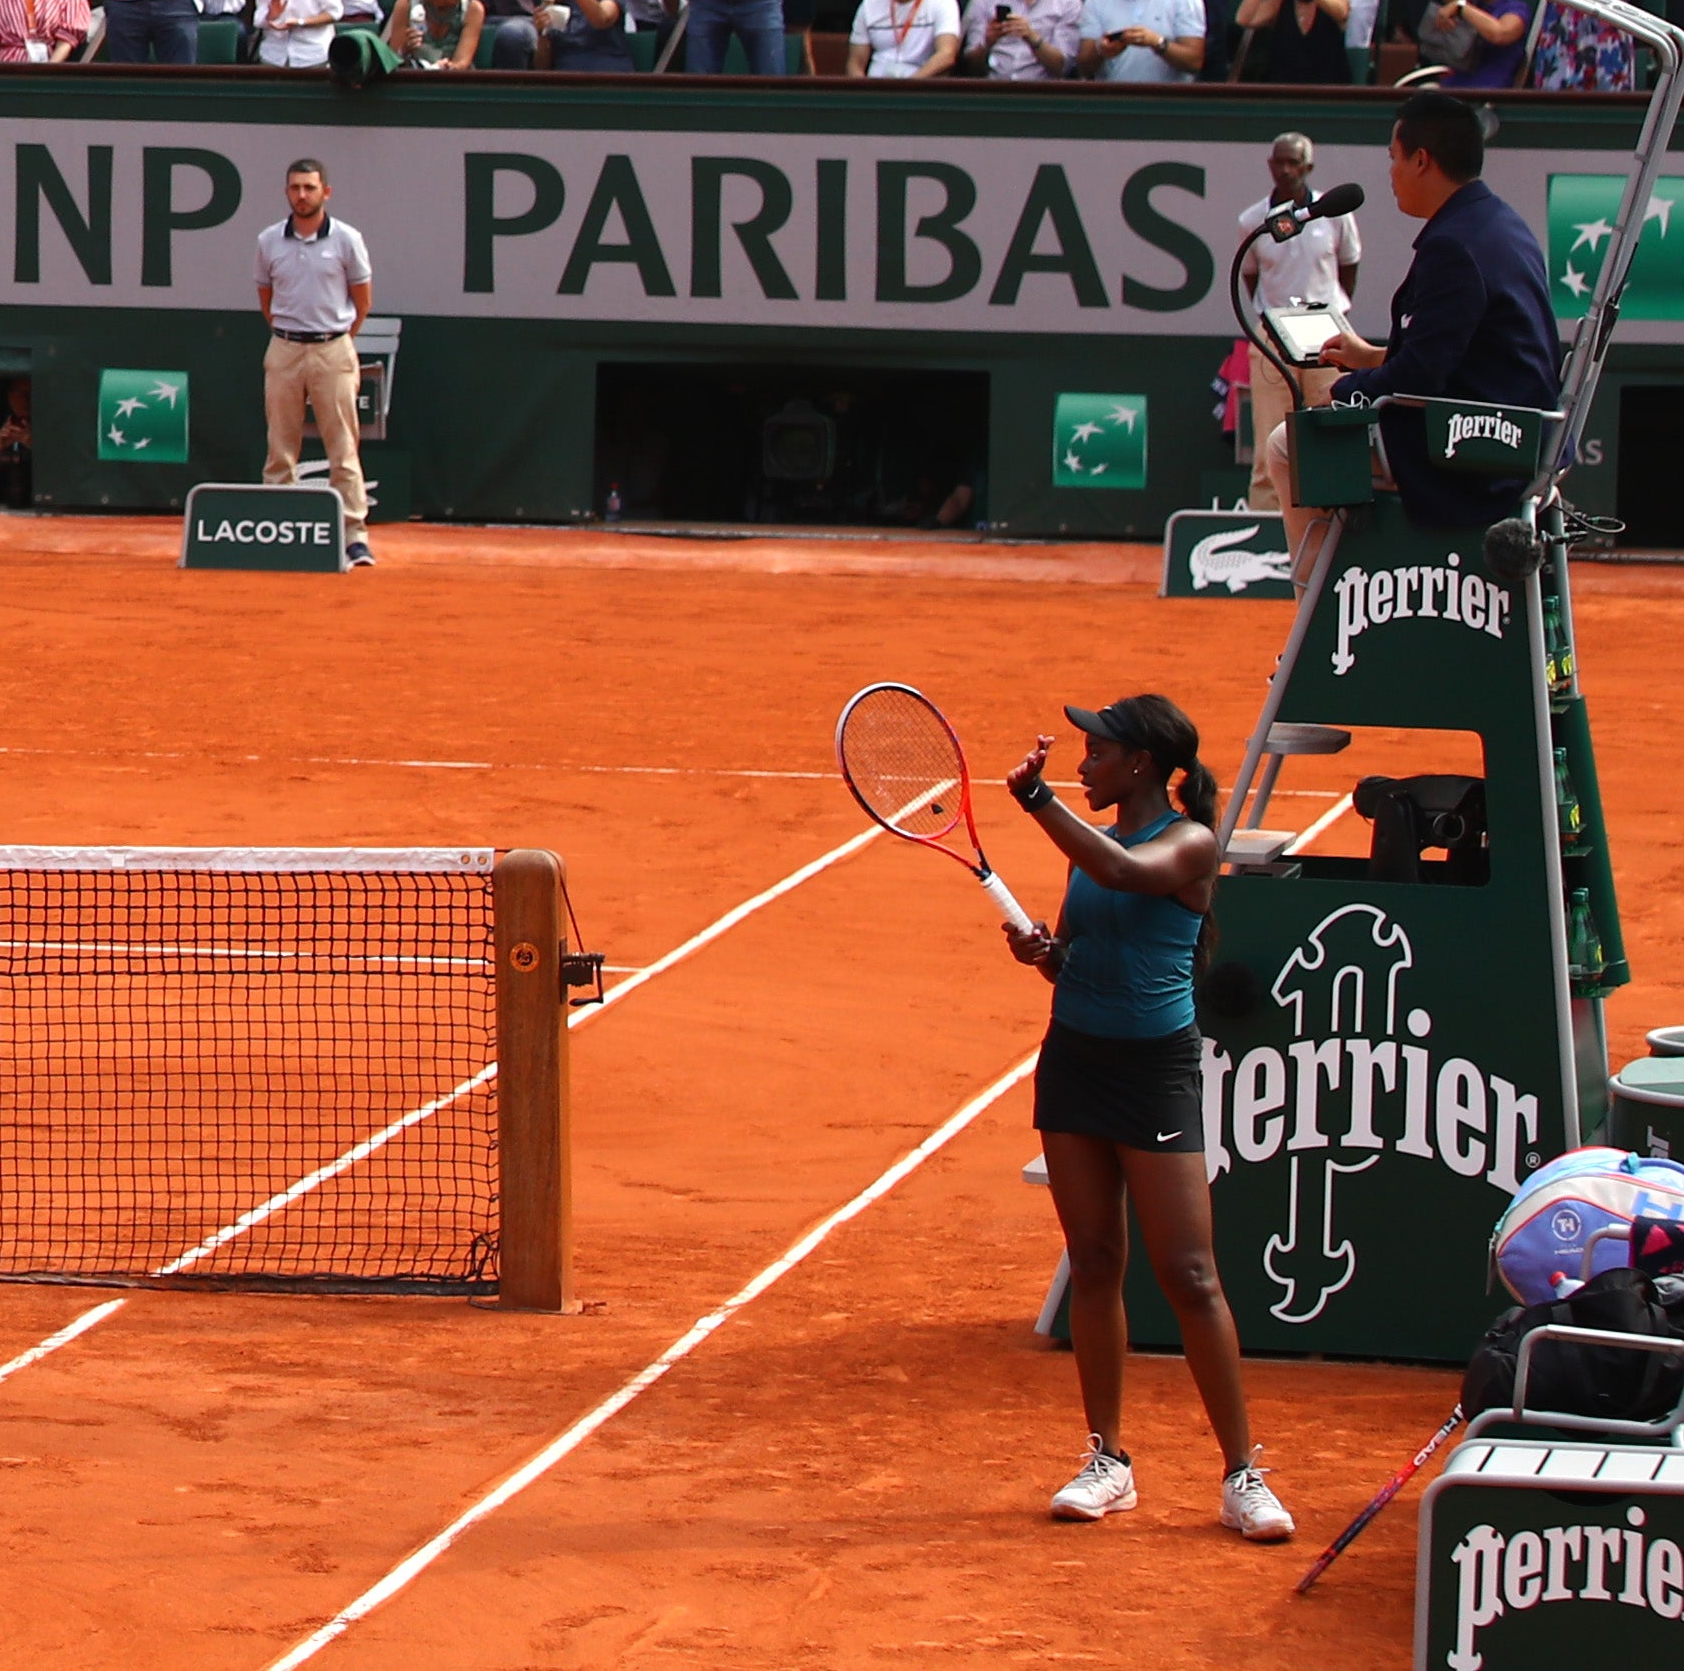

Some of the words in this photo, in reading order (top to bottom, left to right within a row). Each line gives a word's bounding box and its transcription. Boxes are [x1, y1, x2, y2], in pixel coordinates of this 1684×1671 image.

[462, 151, 1215, 314] PARIBAS
[1445, 410, 1522, 460] perrier
[197, 519, 331, 545] LACOSTE
[1331, 552, 1510, 676] perrier
[1413, 1416, 1459, 1466] HEAD
[1446, 1505, 1684, 1671] perrie
